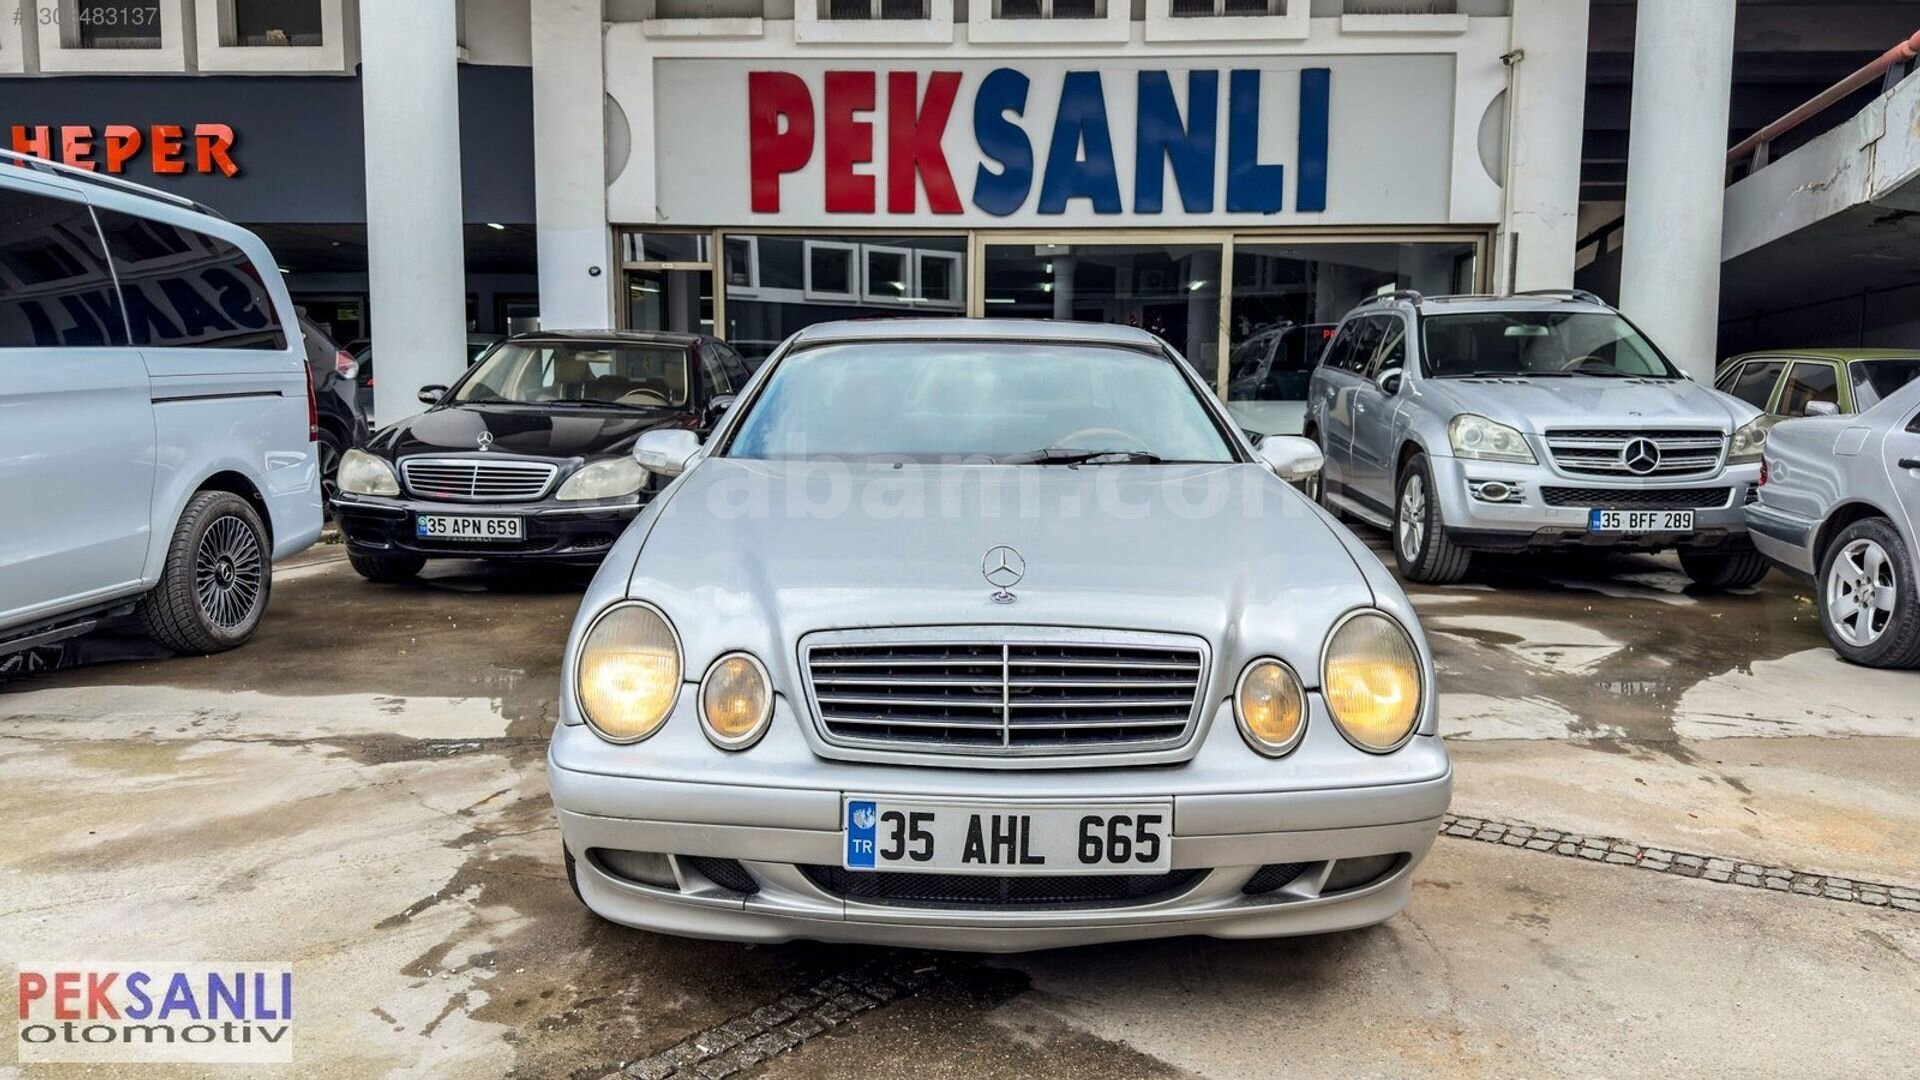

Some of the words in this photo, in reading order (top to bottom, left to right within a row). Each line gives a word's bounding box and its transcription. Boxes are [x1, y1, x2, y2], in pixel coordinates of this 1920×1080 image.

[10, 122, 241, 178] HEPER
[747, 67, 1332, 217] PEKSANLI
[428, 518, 447, 533] 35
[452, 519, 482, 534] APN
[487, 520, 518, 535] 659
[1602, 512, 1620, 528] 35
[1629, 512, 1658, 529] BFF
[1664, 512, 1692, 529] 289
[852, 839, 873, 854] TR
[880, 811, 935, 862] 35
[961, 814, 1046, 865] AHL
[1078, 813, 1163, 864] 665
